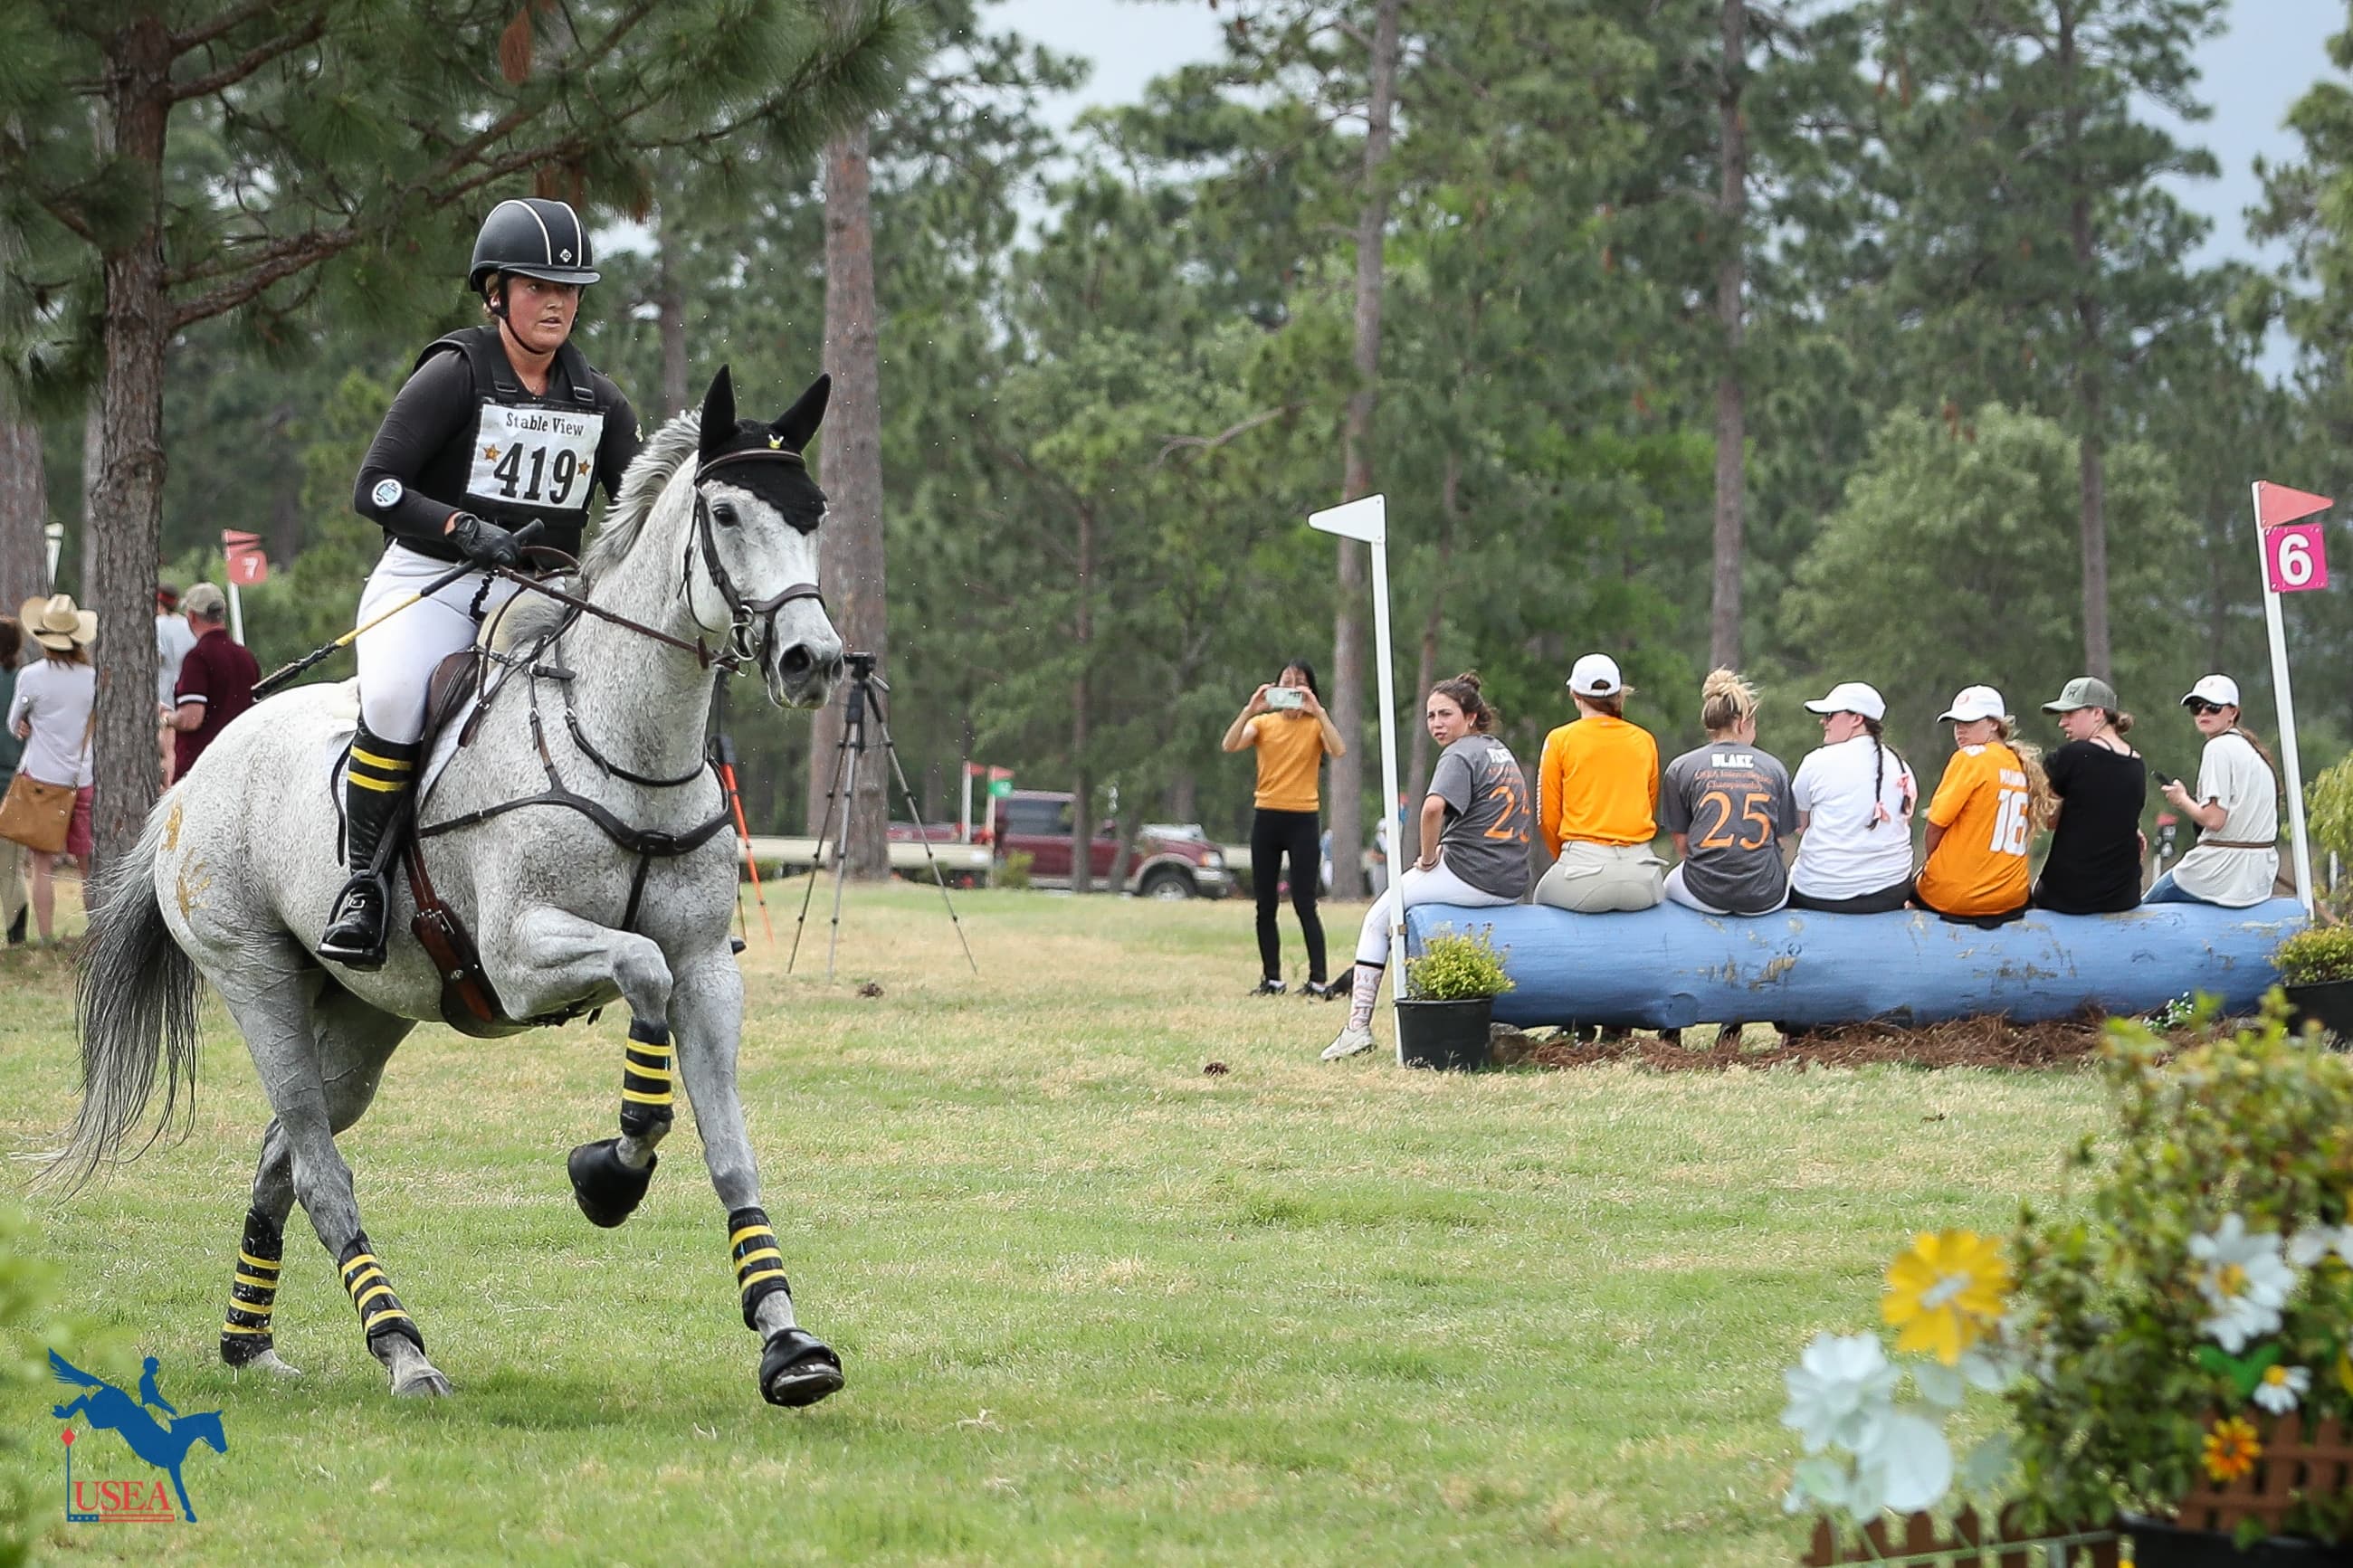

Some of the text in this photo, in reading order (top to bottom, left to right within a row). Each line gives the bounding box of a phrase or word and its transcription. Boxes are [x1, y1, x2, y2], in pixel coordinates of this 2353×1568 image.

[506, 412, 585, 436] Stable View
[493, 442, 577, 504] 419
[241, 556, 260, 579] 7
[2279, 533, 2313, 586] 6
[1711, 753, 1754, 769] BLAKE
[1700, 791, 1771, 851] 25
